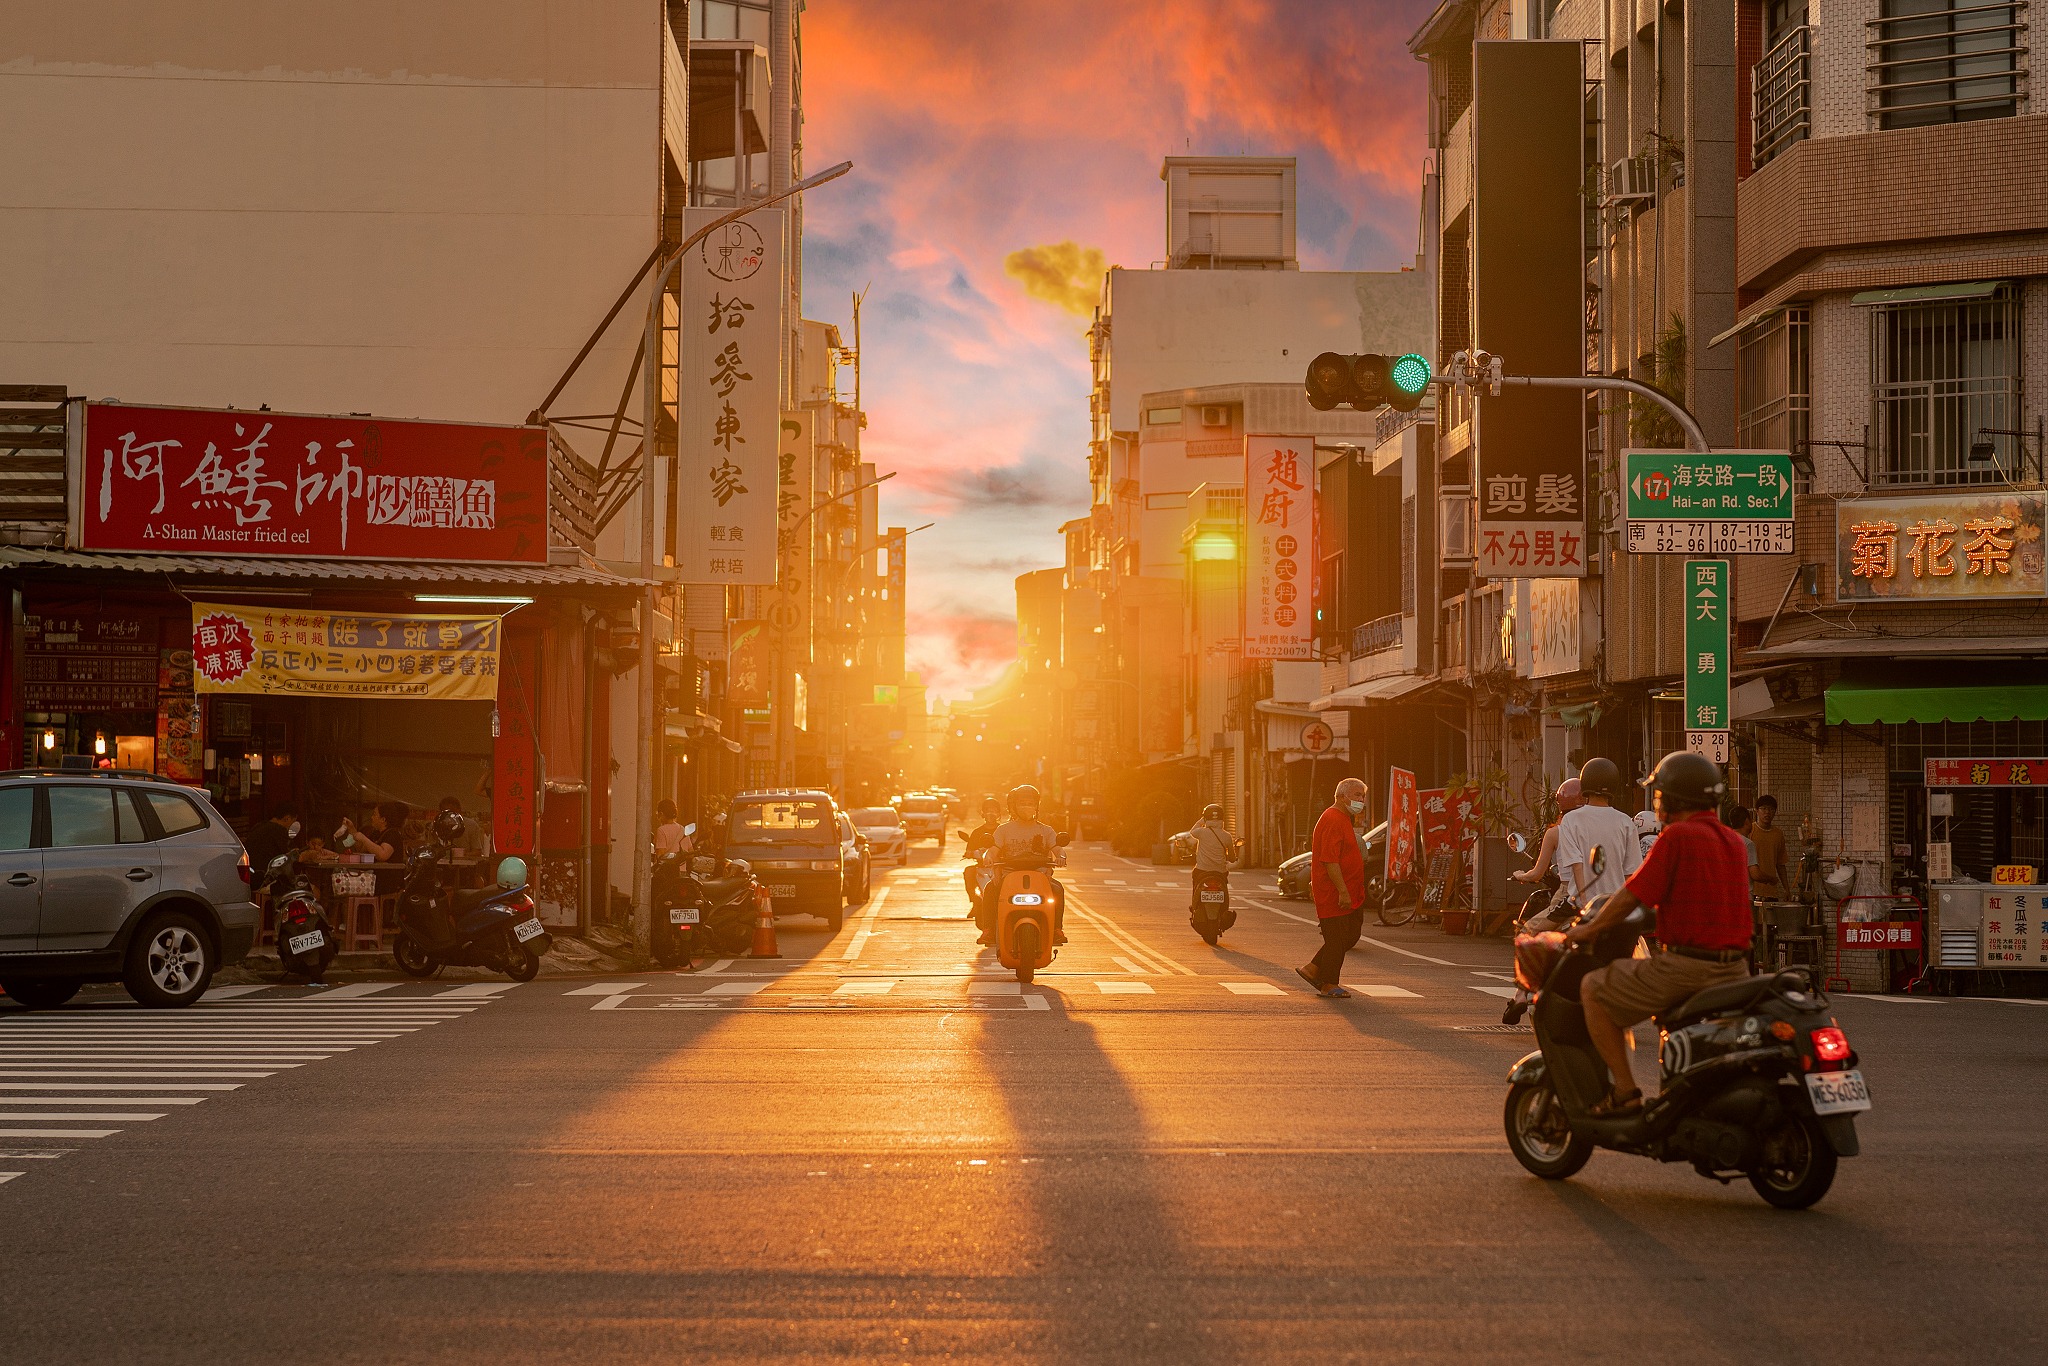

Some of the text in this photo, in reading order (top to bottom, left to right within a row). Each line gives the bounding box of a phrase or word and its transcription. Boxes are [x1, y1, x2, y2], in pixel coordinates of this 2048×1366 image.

[724, 225, 742, 247] 13
[708, 291, 755, 508] 拾參東家
[1672, 463, 1778, 488] 海安路一段
[100, 422, 363, 551] 阿鱔師
[1256, 448, 1305, 530] 趙廚
[1486, 473, 1578, 514] 剪髮
[1644, 479, 1671, 497] 171
[367, 475, 495, 529] 炒鱔魚
[1672, 495, 1779, 508] Hai-an Rd. Sec.1
[143, 523, 310, 544] A-Shan Master fried eel
[710, 525, 744, 542] 輕食
[1629, 523, 1646, 541] 南
[1721, 523, 1792, 540] 87-119 北
[1482, 530, 1581, 566] 不分男女
[1629, 542, 1640, 551] S.
[1713, 539, 1785, 552] 100-170 N.
[1850, 515, 2016, 579] 菊花茶
[709, 558, 744, 575] 烘培
[1696, 566, 1717, 586] 西
[1275, 536, 1297, 625] 中式料理
[263, 612, 325, 629] 自家批發
[200, 623, 242, 648] 再次
[262, 630, 325, 646] 面子問題
[332, 618, 495, 650] 賠了就算了
[1259, 635, 1299, 645] 團體聚餐
[203, 649, 245, 675] 凍漲
[1249, 646, 1307, 657] 06-2220079
[1696, 599, 1718, 726] 大勇街
[1690, 734, 1725, 746] 39 28
[1971, 763, 2032, 786] 菊花
[1996, 866, 2031, 883] 已售完
[1989, 896, 2002, 934] 紅茶
[2014, 895, 2027, 936] 冬瓜茶
[1846, 928, 1912, 943] 請勿 停車
